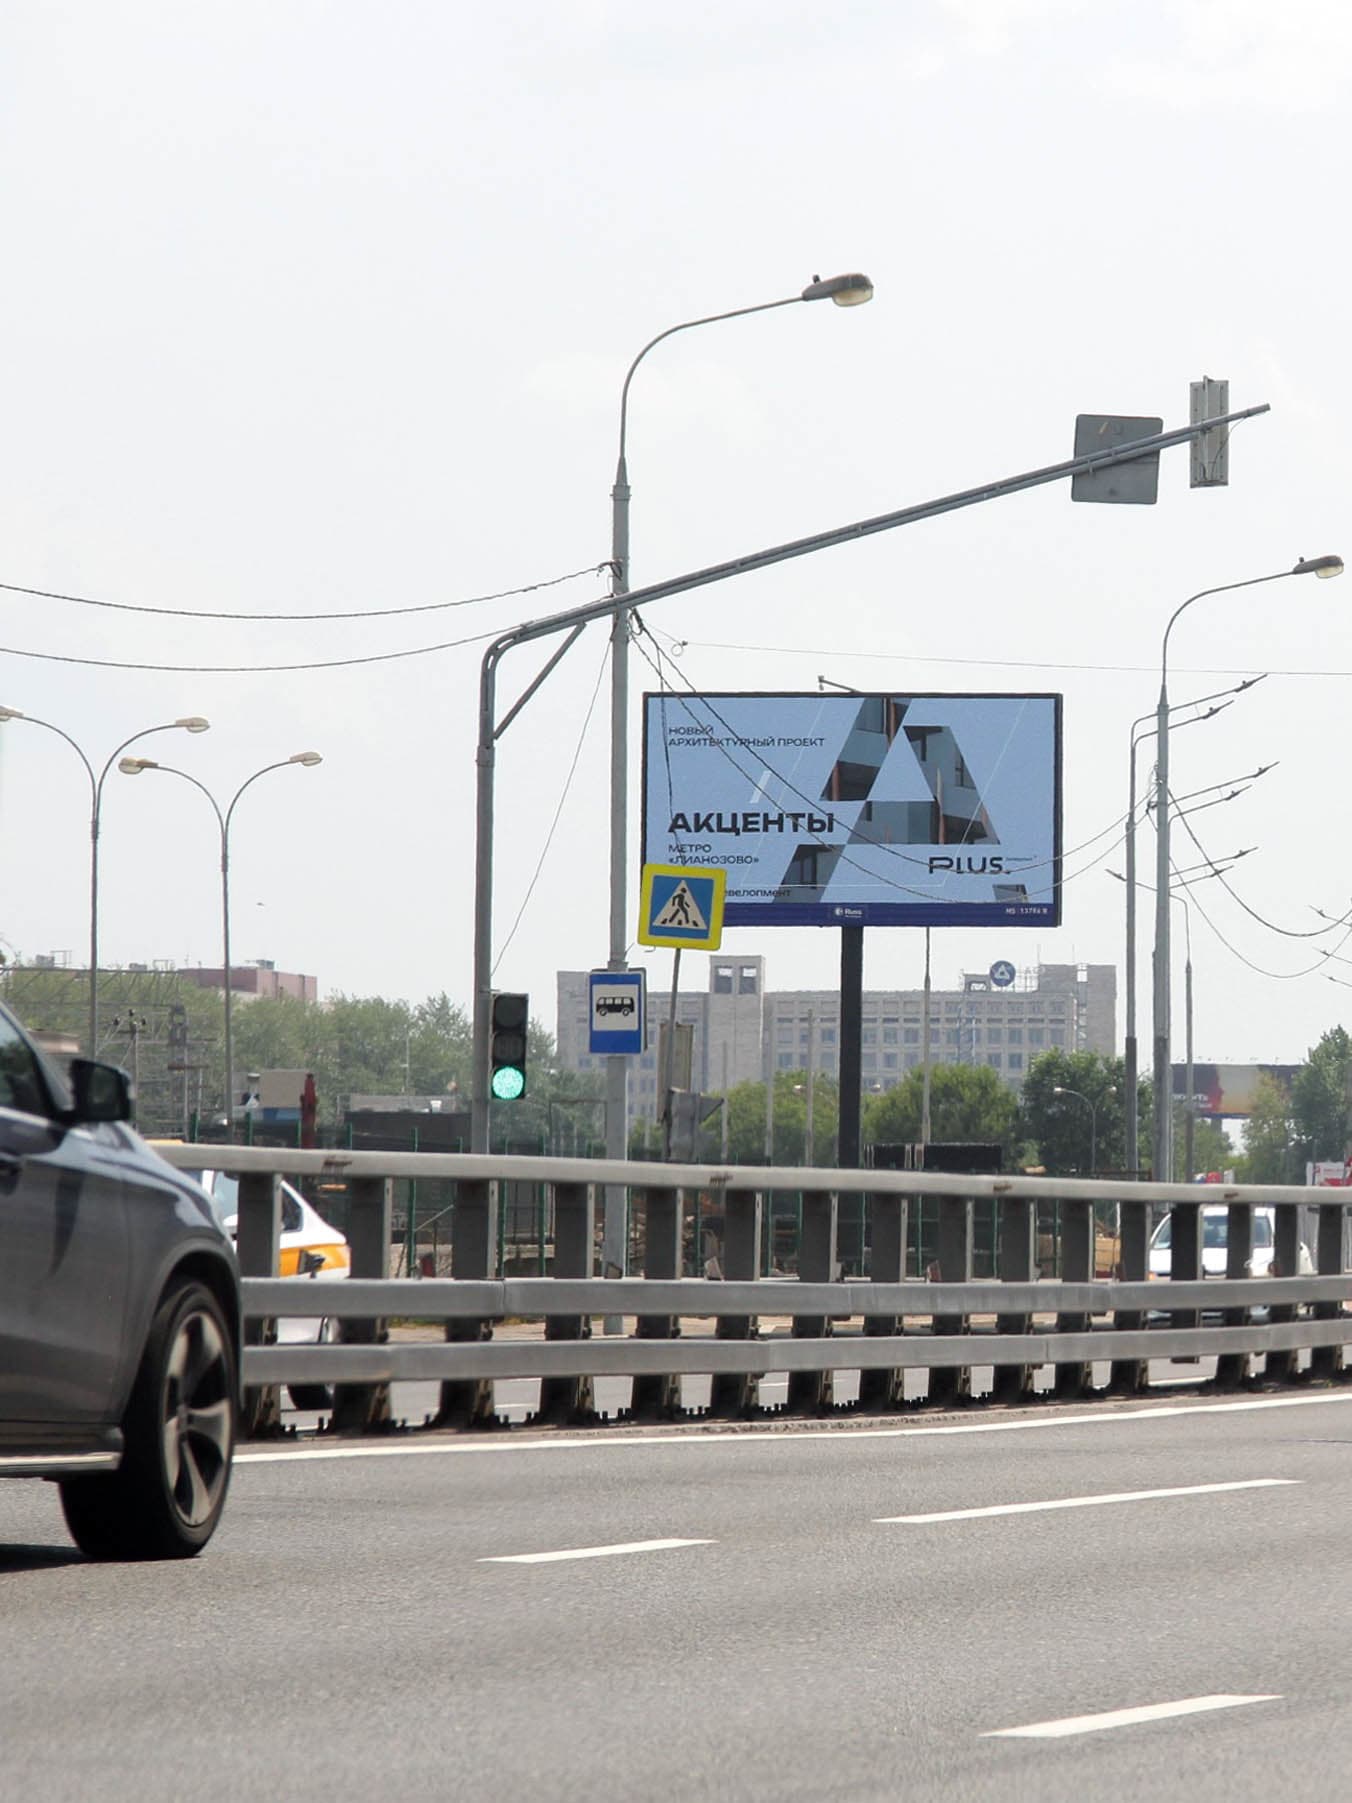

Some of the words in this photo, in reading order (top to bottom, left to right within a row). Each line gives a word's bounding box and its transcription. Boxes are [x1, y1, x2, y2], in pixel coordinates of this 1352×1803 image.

[668, 725, 713, 735] НОВЫЙ
[668, 736, 775, 747] АРХИТЕКТУРНЫЙ
[777, 737, 825, 747] ПРОЕКТ
[667, 812, 834, 836] АКЦЕНТЫ
[668, 843, 712, 854] МЕТРО
[668, 854, 759, 865] «ЛИАНОЗОВО»
